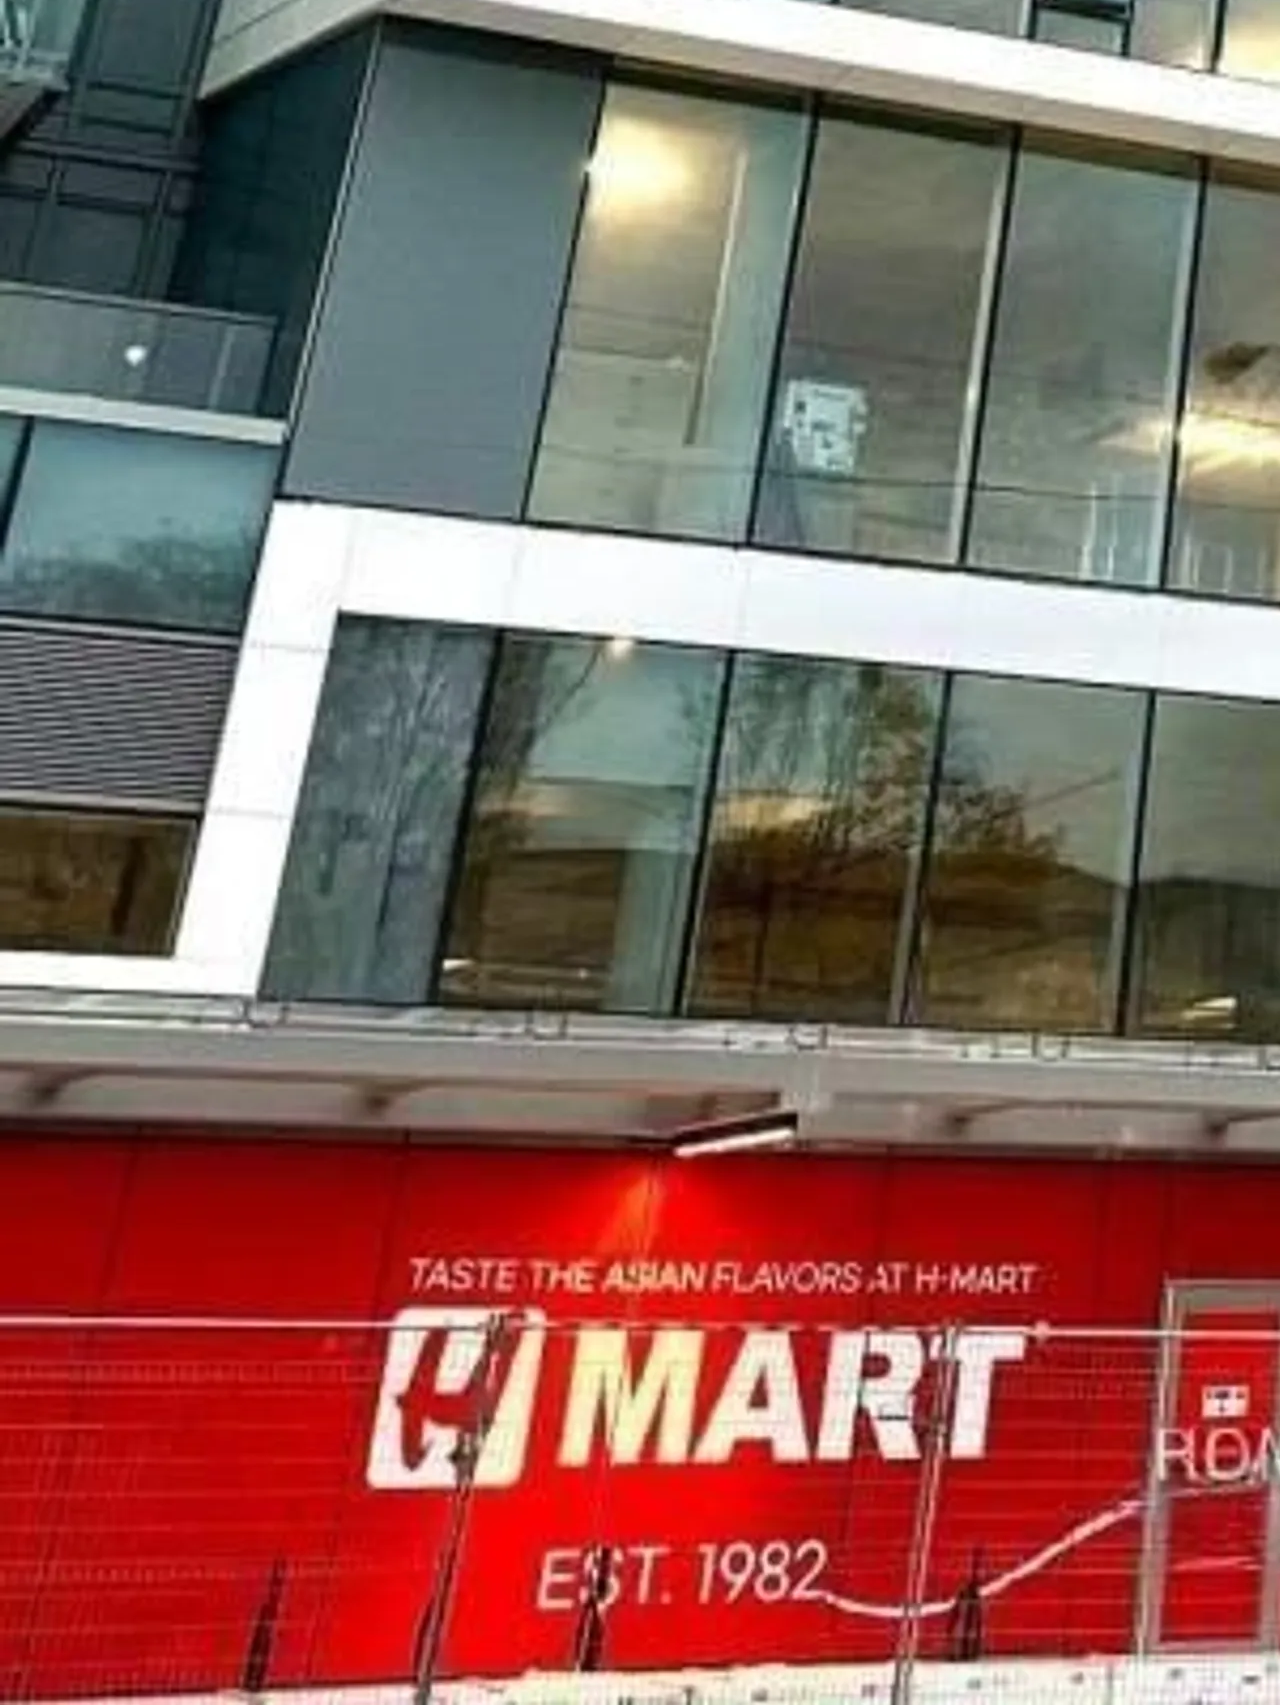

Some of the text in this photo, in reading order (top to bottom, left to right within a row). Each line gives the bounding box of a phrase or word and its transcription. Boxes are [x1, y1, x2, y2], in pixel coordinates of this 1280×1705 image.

[409, 1256, 521, 1292] TASTE
[529, 1258, 599, 1293] THE
[602, 1259, 707, 1294] ASIAN
[711, 1260, 864, 1295] FLAVORS
[867, 1261, 910, 1295] AT
[556, 1328, 1026, 1468] MART
[536, 1539, 830, 1611] EST. 1982
